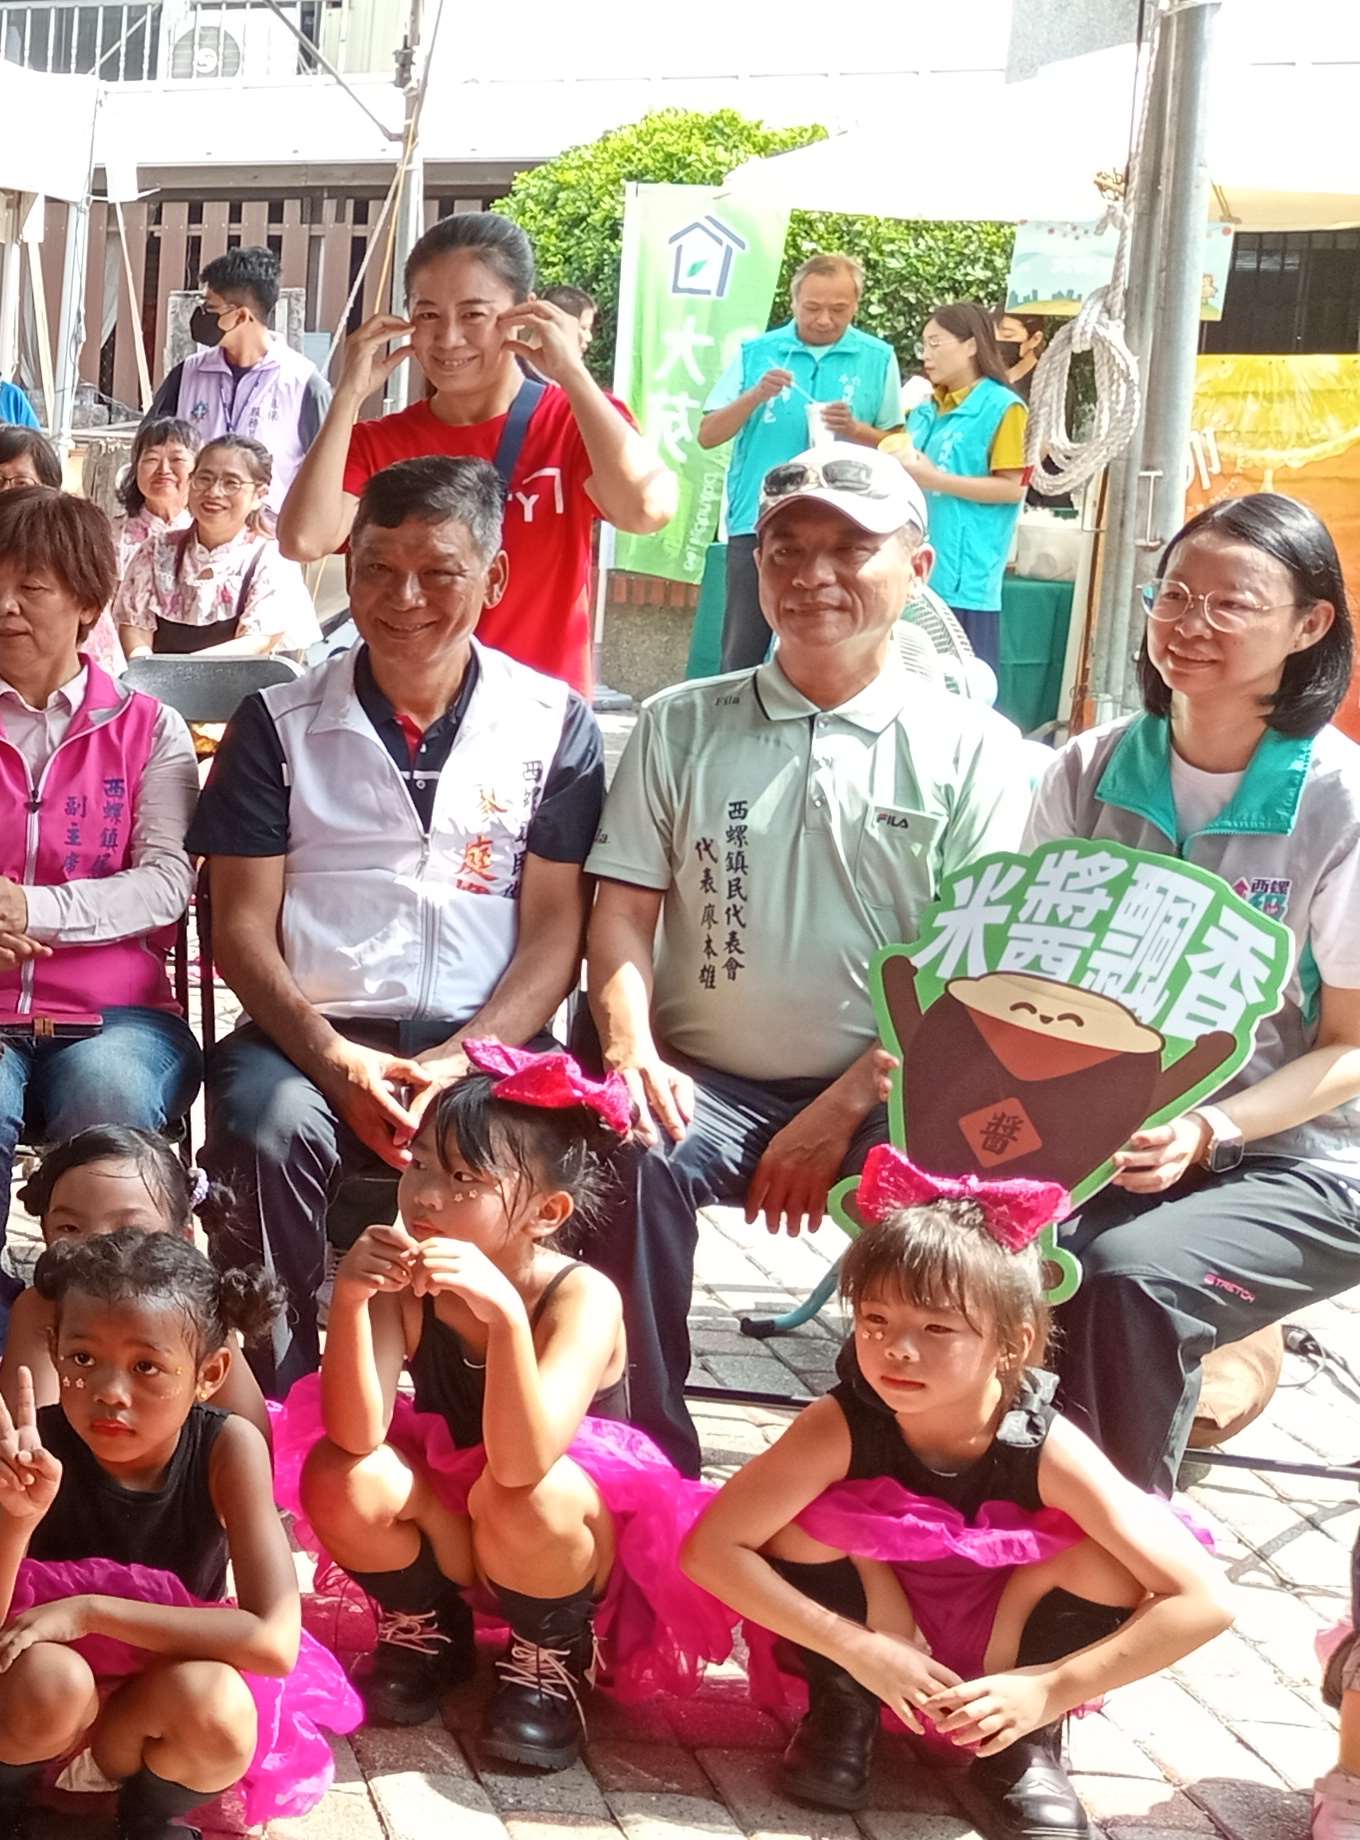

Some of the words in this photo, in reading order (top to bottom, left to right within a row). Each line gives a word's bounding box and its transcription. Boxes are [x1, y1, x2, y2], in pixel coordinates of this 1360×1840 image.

[876, 813, 909, 829] FILA
[721, 800, 749, 981] 西螺鎮民代表會
